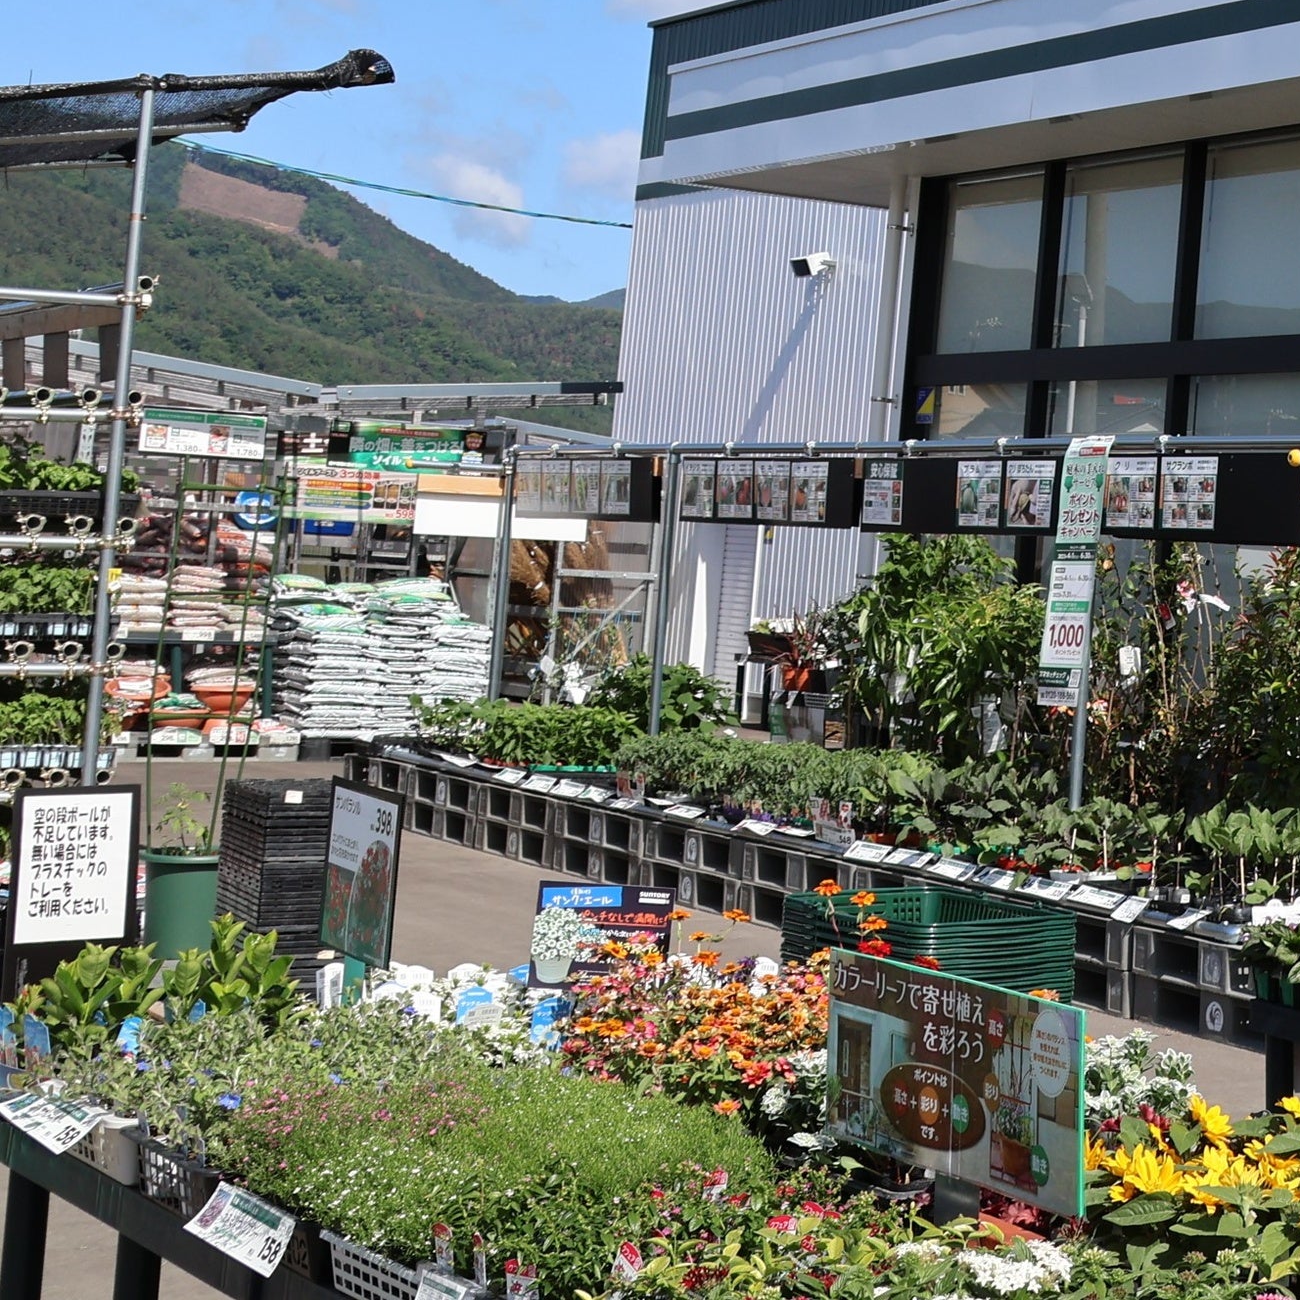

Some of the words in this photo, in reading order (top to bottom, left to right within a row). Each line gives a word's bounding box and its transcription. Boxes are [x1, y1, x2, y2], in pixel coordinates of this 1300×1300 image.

[1069, 493, 1096, 506] ポイント
[1062, 509, 1100, 524] プレゼント
[1060, 526, 1097, 538] キャンペーン
[1049, 624, 1084, 648] 1,000
[34, 806, 111, 825] 空の段ボールが
[375, 807, 393, 836] 398
[32, 824, 114, 843] 不足しています。
[31, 843, 98, 862] 無い場合には
[31, 861, 108, 879] プラスチックの
[30, 882, 73, 899] トレーを
[638, 891, 671, 899] SUNTORY
[28, 898, 109, 917] ご利用ください。
[834, 960, 985, 1027] カラーリーフで寄せ植え
[988, 1018, 1004, 1038] 高さ
[923, 1021, 984, 1064] を彩ろう
[913, 1068, 948, 1088] ポイントは
[983, 1082, 999, 1100] 彩り
[52, 1125, 80, 1147] 158
[920, 1124, 939, 1142] です。
[256, 1236, 283, 1264] 158
